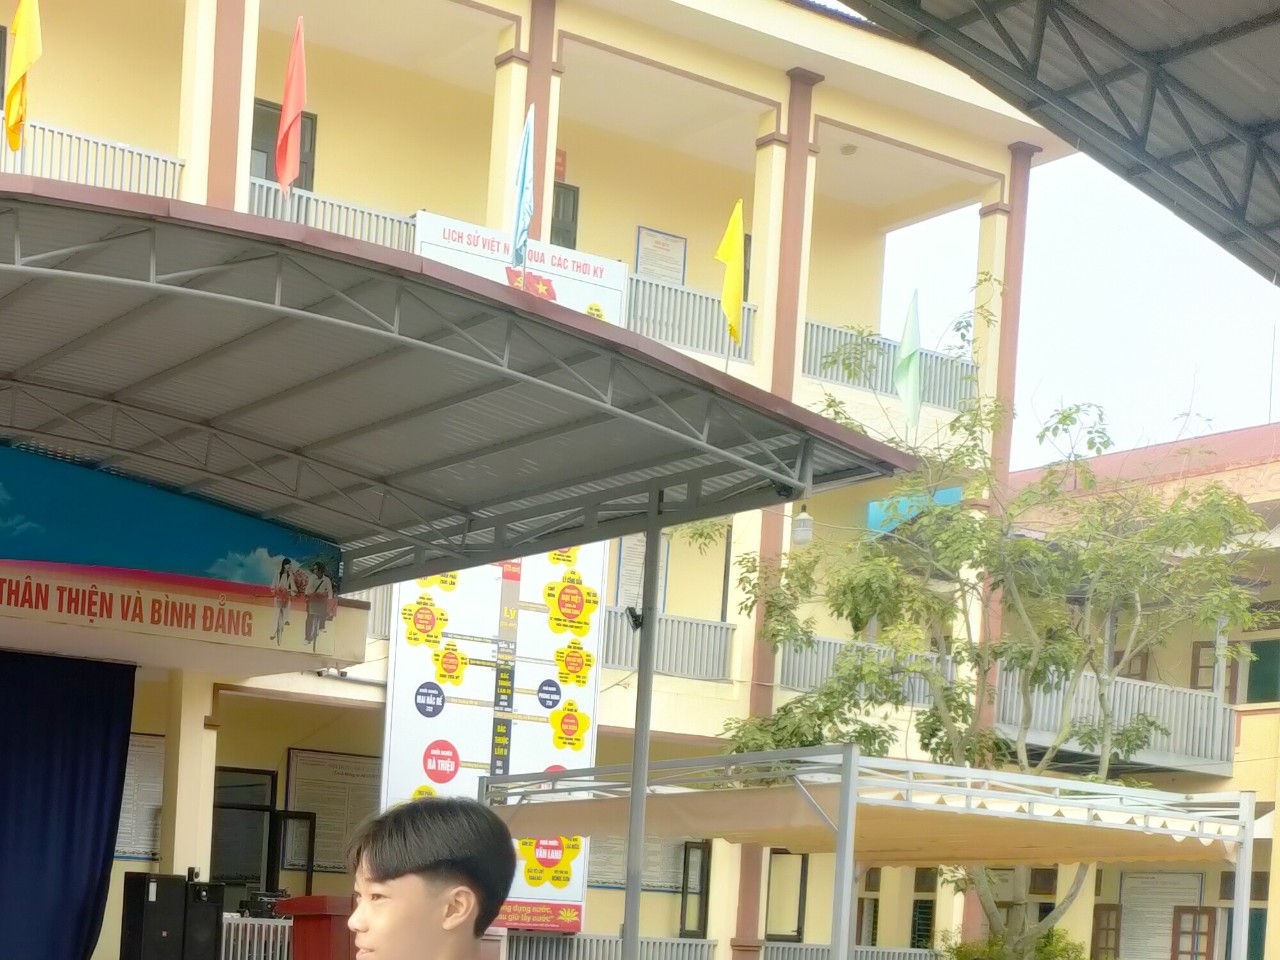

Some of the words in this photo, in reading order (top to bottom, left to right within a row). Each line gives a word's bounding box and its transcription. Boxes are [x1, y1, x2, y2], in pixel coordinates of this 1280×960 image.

[442, 227, 464, 245] LỊCH
[466, 230, 481, 247] SỬ
[482, 234, 502, 254] VIỆT
[527, 249, 545, 265] QUA
[551, 254, 569, 271] CÁC
[56, 585, 113, 623] THIỆN
[120, 589, 144, 623] VÀ
[150, 594, 196, 630] BÌNH
[202, 595, 253, 638] ĐẲNG
